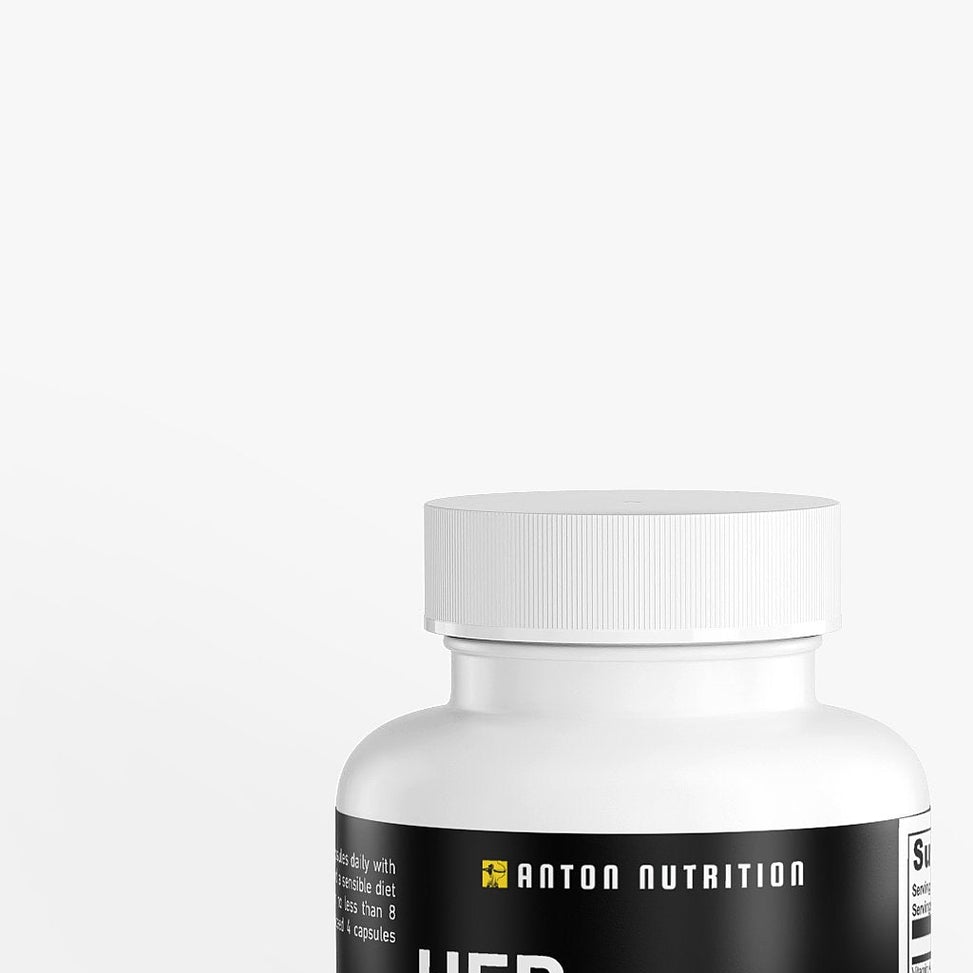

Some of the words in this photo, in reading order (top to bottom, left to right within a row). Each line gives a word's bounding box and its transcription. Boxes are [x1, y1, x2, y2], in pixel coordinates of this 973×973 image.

[350, 852, 370, 874] daily
[373, 857, 396, 874] with
[517, 864, 619, 891] ANTON
[639, 859, 805, 891] NUTRITION
[342, 876, 372, 894] sensible
[375, 879, 396, 898] diet
[362, 900, 382, 918] than
[388, 904, 396, 920] 8
[354, 925, 396, 943] capsules
